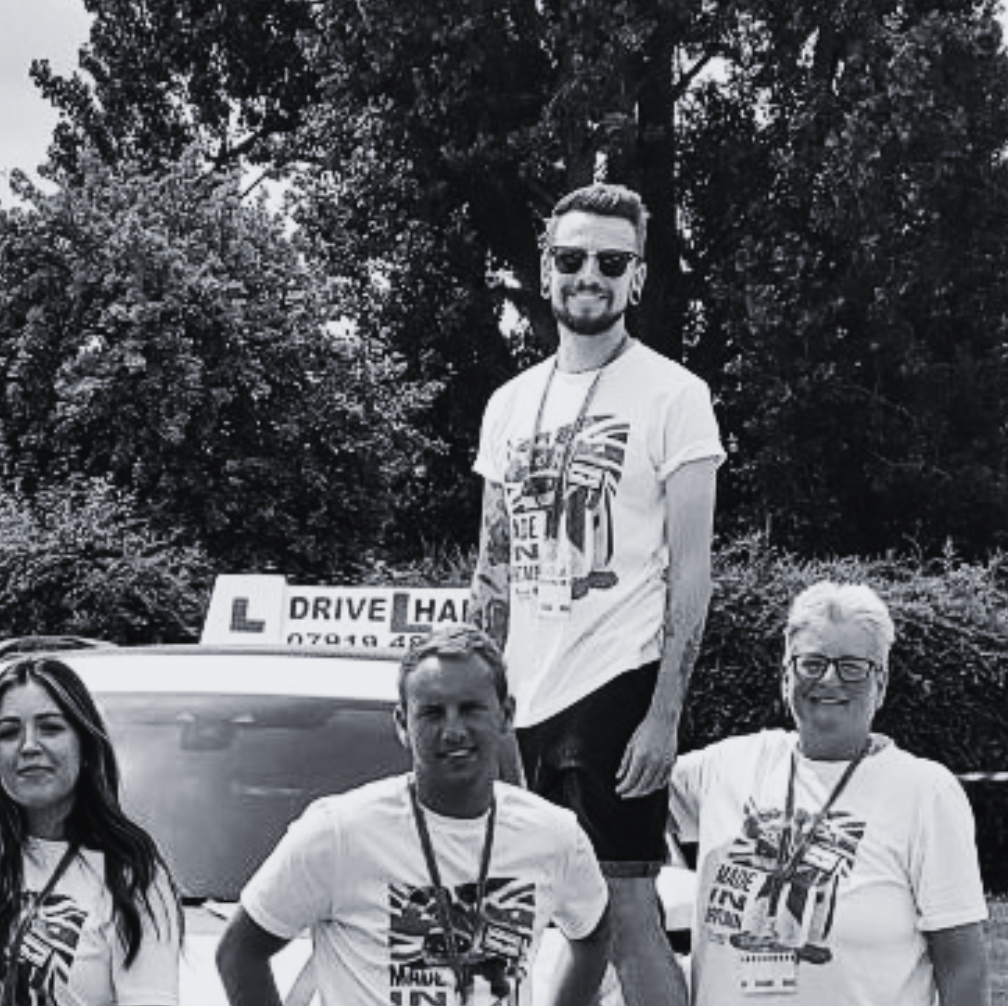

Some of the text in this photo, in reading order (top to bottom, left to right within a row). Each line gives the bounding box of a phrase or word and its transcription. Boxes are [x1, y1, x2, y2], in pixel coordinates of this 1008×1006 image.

[229, 597, 266, 633] L
[290, 596, 386, 621] DRIVE
[414, 599, 469, 622] HA
